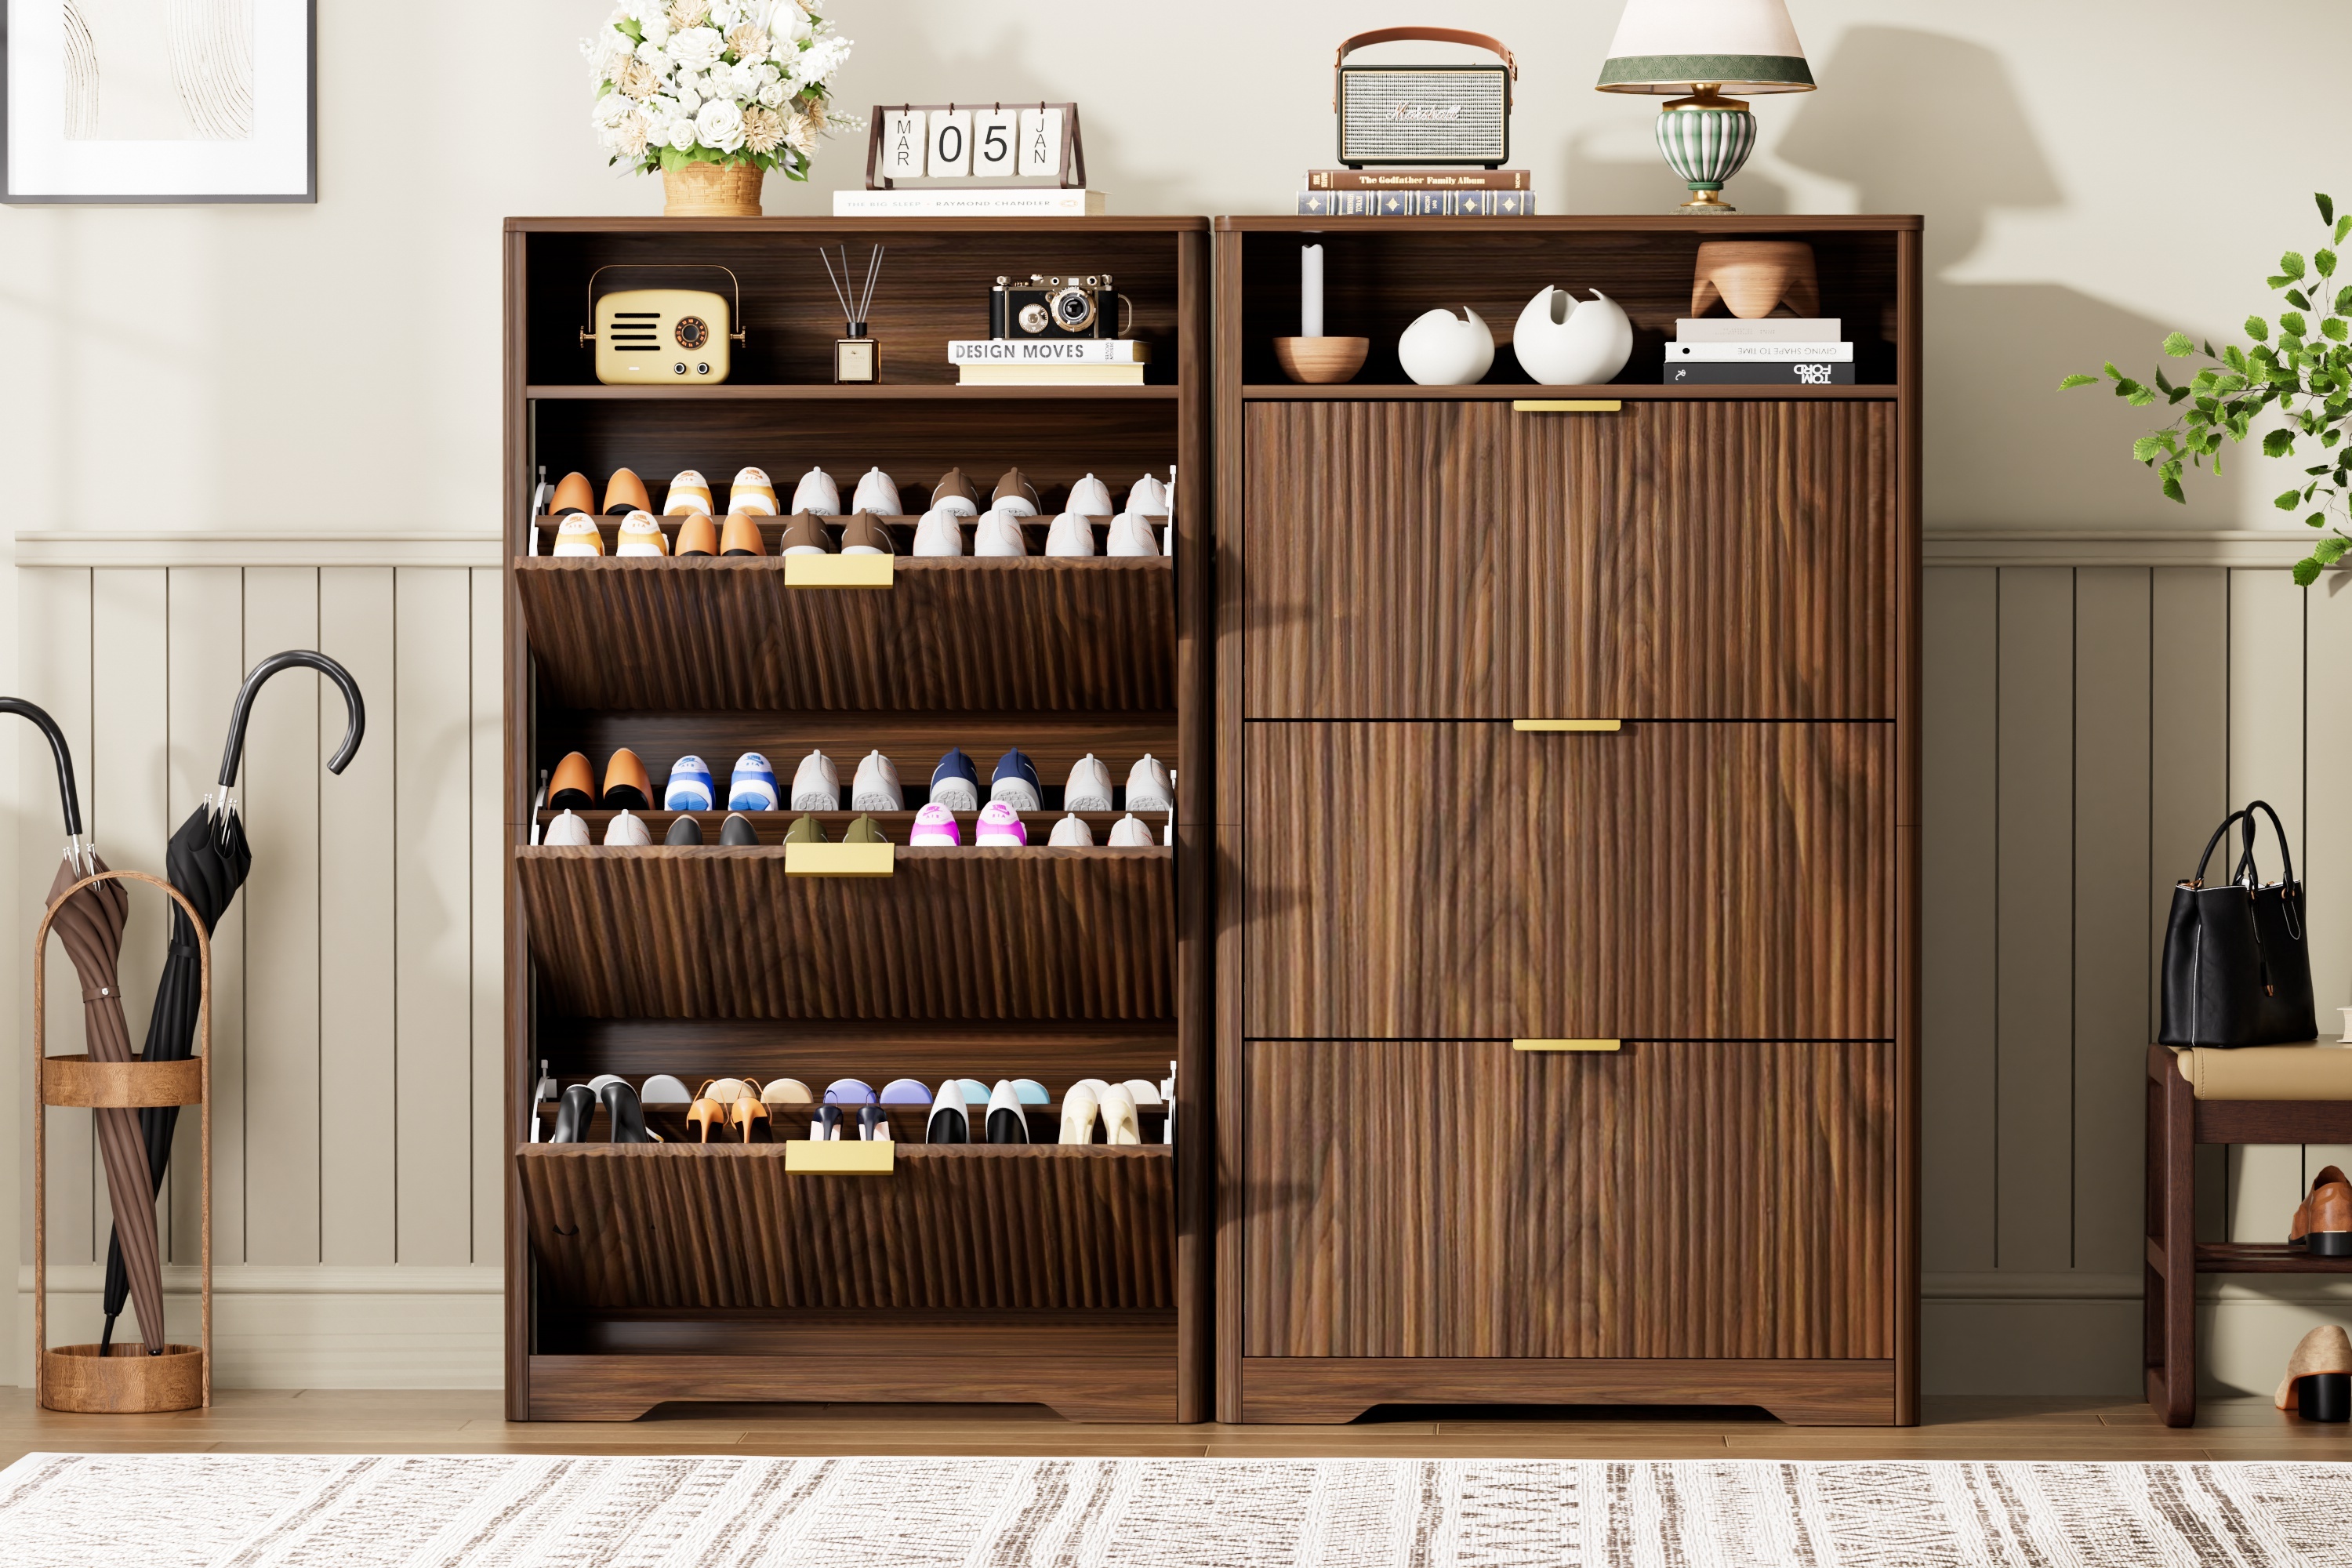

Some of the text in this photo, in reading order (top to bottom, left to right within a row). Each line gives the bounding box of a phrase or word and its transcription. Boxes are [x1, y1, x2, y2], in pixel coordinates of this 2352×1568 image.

[1386, 100, 1461, 120] Marshall
[897, 120, 911, 166] MAR
[1034, 118, 1047, 164] JAN
[1359, 176, 1377, 184] The
[1378, 176, 1425, 184] Godfather
[1426, 176, 1457, 185] Family
[1355, 195, 1363, 212] TORAH
[956, 344, 1083, 358] DESIGN MOVES
[1793, 364, 1831, 375] FORD
[1801, 374, 1831, 384] TOM
